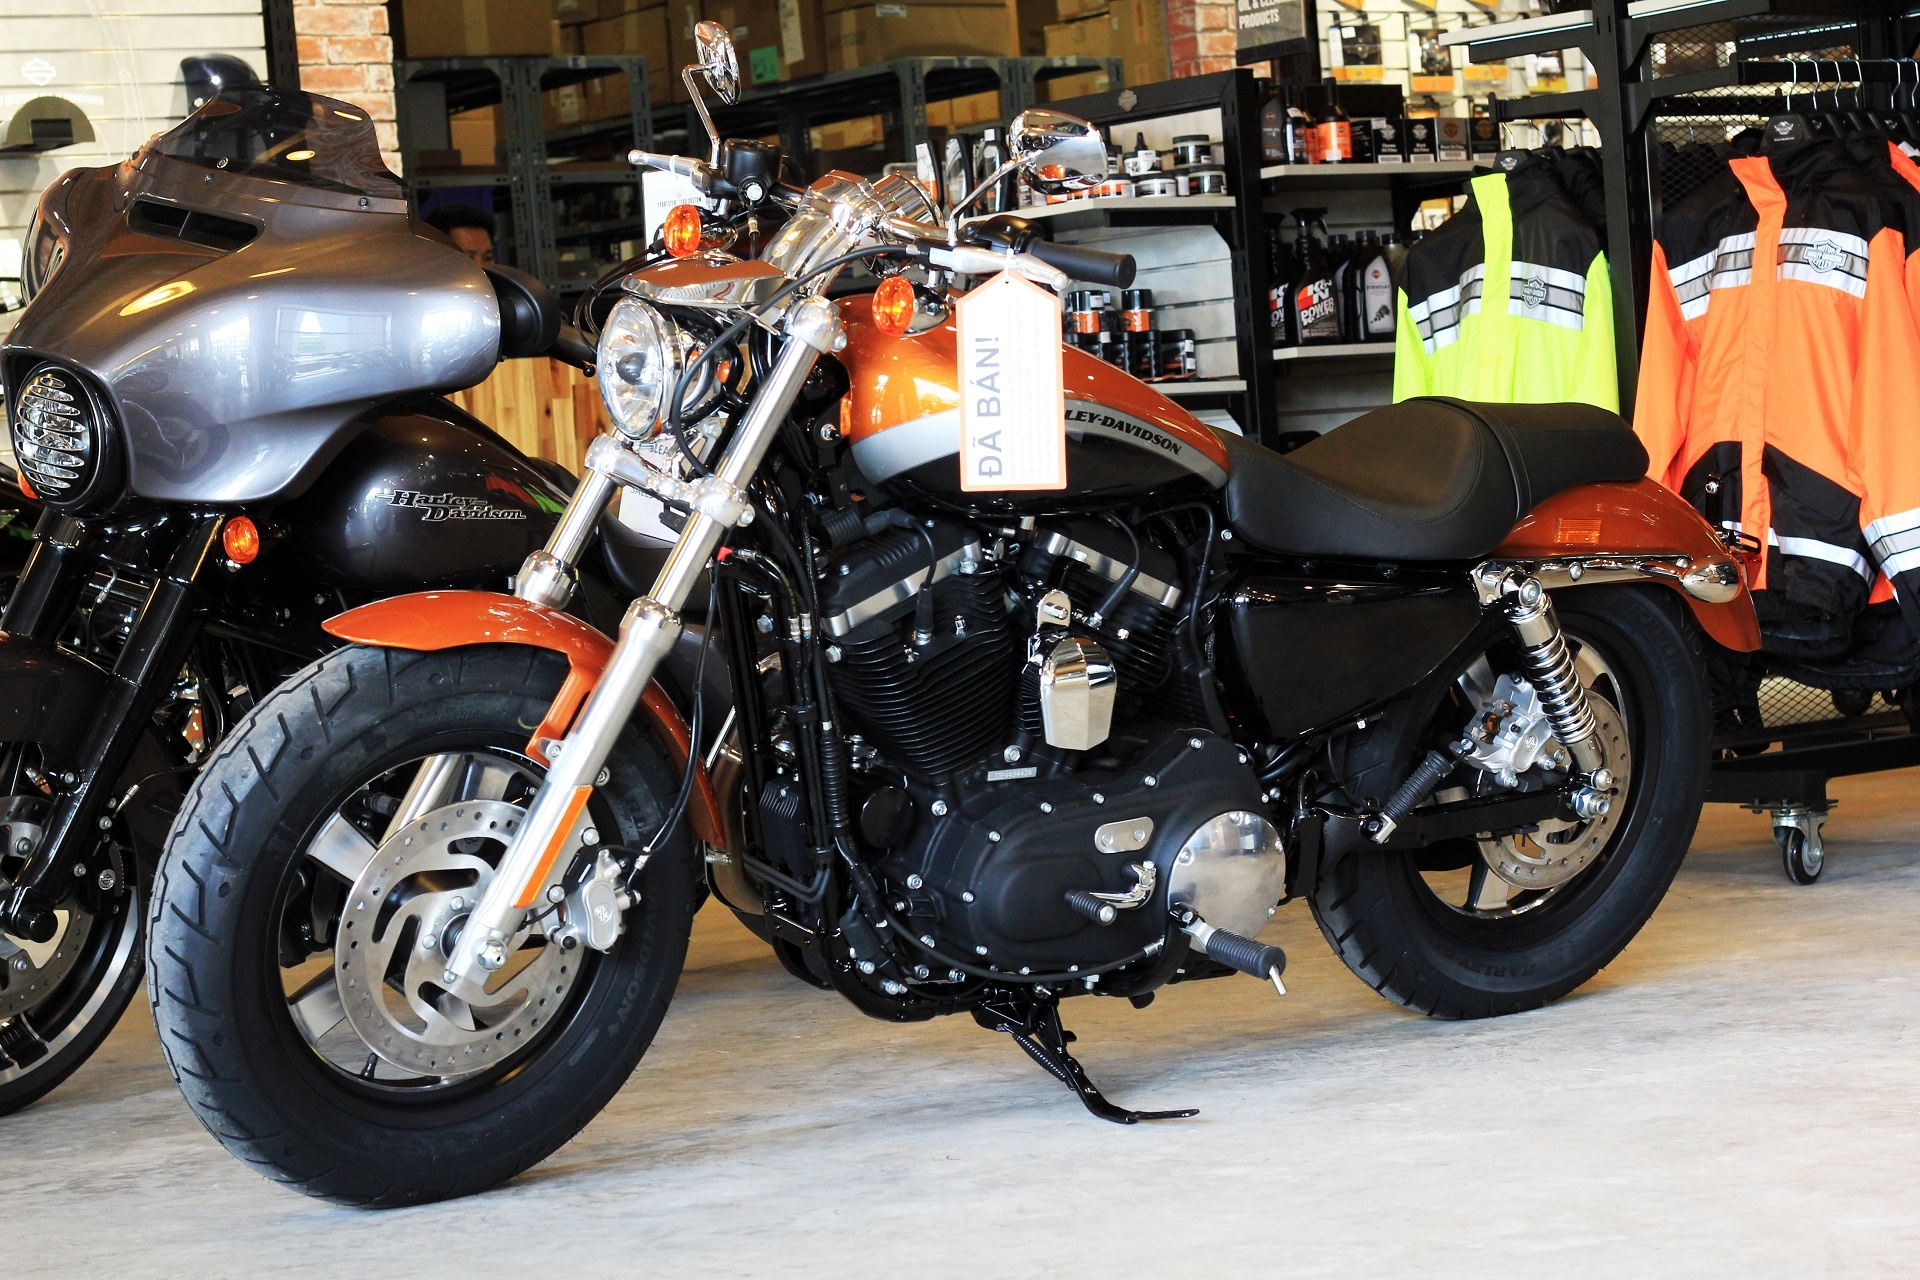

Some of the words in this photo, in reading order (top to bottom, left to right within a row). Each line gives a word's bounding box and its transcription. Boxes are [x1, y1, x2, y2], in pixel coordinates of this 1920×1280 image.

[1239, 8, 1280, 30] PRODUCTS
[1306, 279, 1333, 304] K&N
[1300, 297, 1335, 322] POWER
[970, 336, 1001, 417] BÁN!
[973, 429, 1003, 478] ĐÃ
